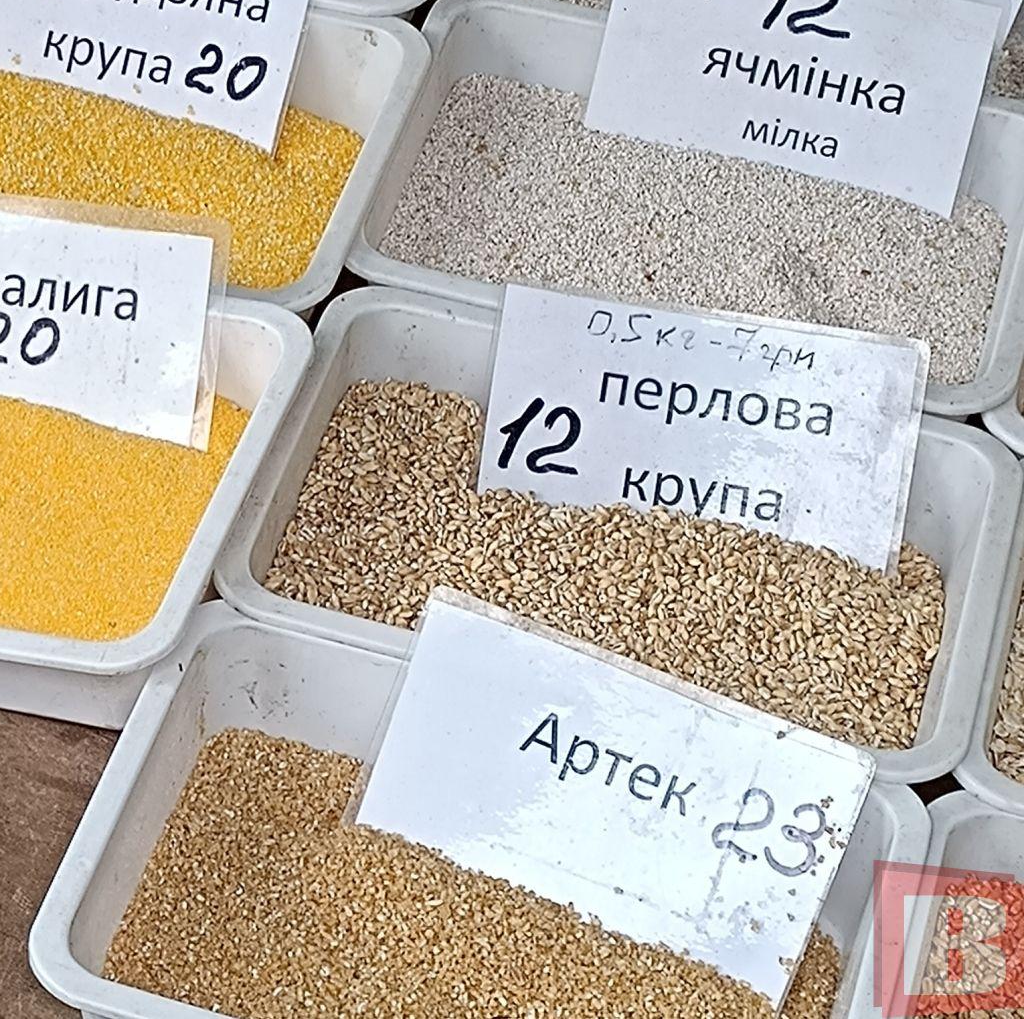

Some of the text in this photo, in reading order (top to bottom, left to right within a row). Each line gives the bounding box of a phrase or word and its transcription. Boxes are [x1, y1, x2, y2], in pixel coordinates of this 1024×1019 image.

[42, 29, 268, 101] крупа 20
[702, 46, 907, 116] ячмінка
[741, 118, 839, 159] мілка
[598, 371, 836, 437] перлова
[496, 396, 784, 523] 12 крупа
[519, 711, 828, 877] Артек 23
